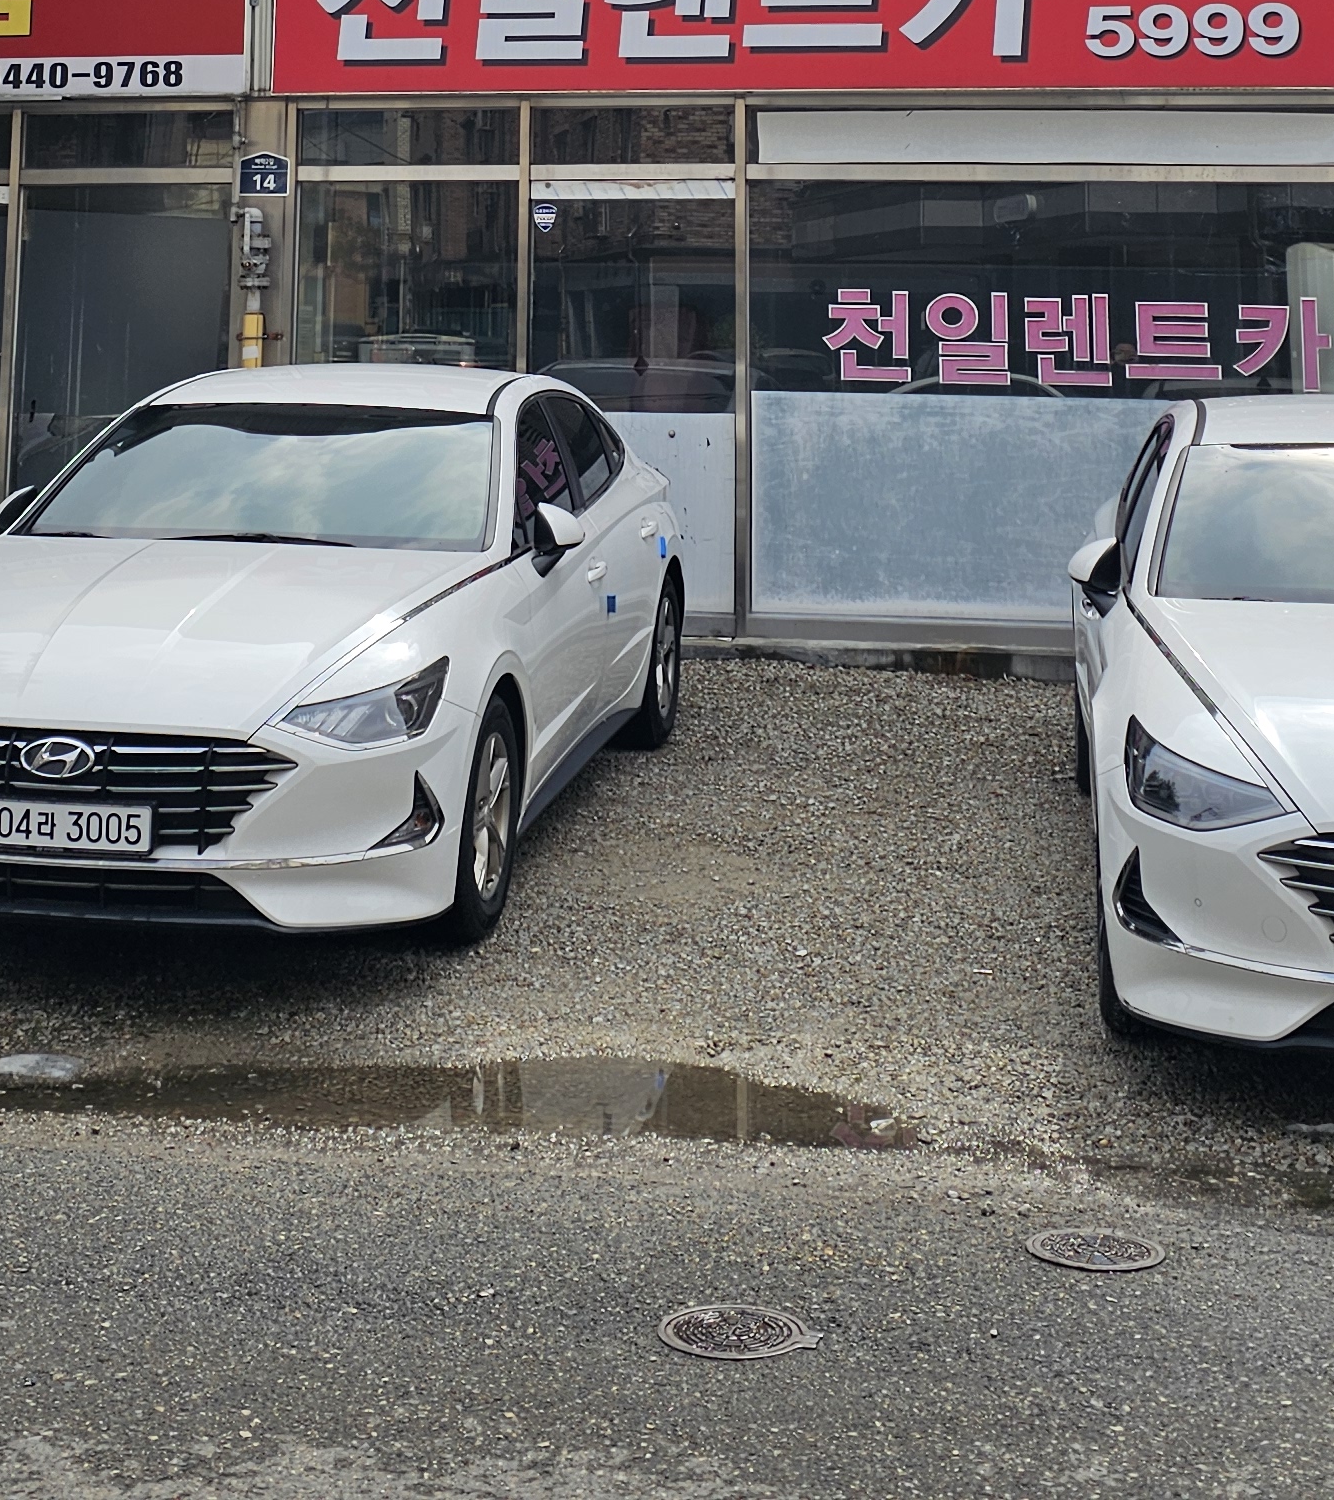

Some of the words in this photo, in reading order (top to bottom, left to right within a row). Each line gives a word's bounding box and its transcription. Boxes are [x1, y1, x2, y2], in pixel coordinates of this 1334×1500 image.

[1084, 2, 1301, 58] 5999
[252, 174, 276, 190] 14
[822, 288, 1332, 392] 천일렌트카
[66, 811, 142, 846] 3005
